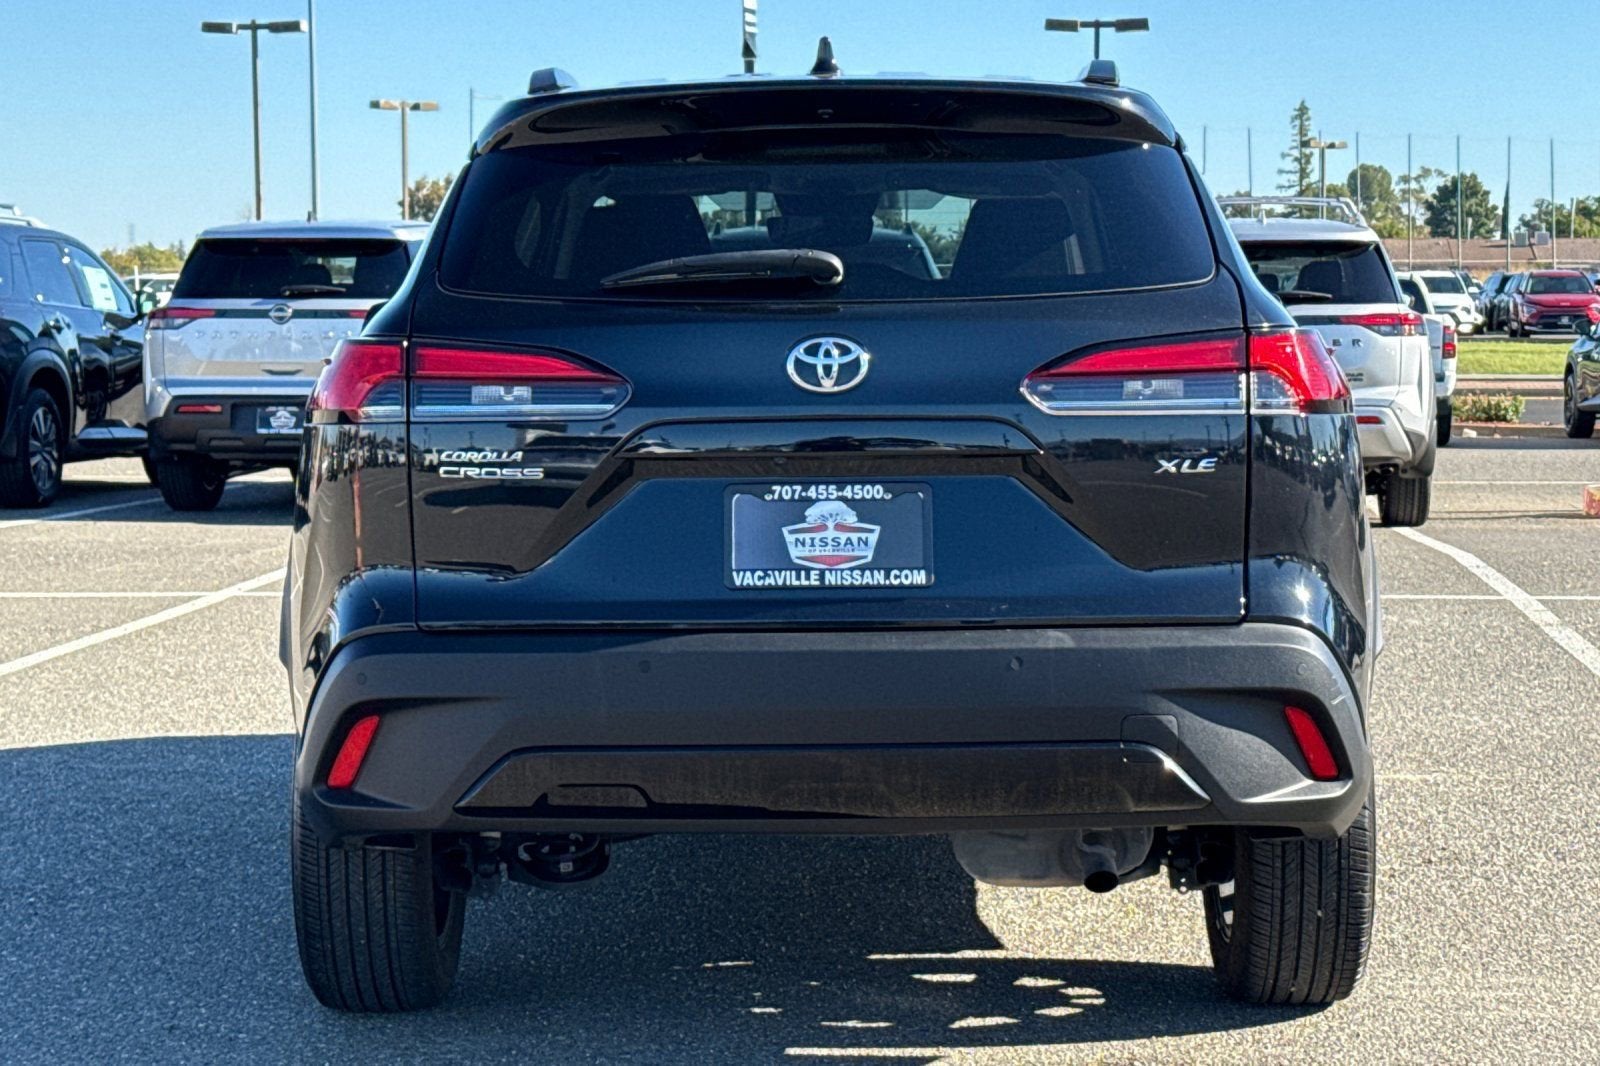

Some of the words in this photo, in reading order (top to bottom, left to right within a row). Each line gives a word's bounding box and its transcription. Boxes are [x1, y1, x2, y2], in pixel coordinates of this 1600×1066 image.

[440, 450, 524, 463] COROLLA
[1153, 457, 1218, 473] XLE
[439, 466, 545, 479] CROSS
[771, 485, 884, 500] 707-455-4500
[794, 536, 869, 548] NISSAN
[732, 570, 820, 586] VACAVILLE
[824, 569, 926, 585] NISSAN.COM
